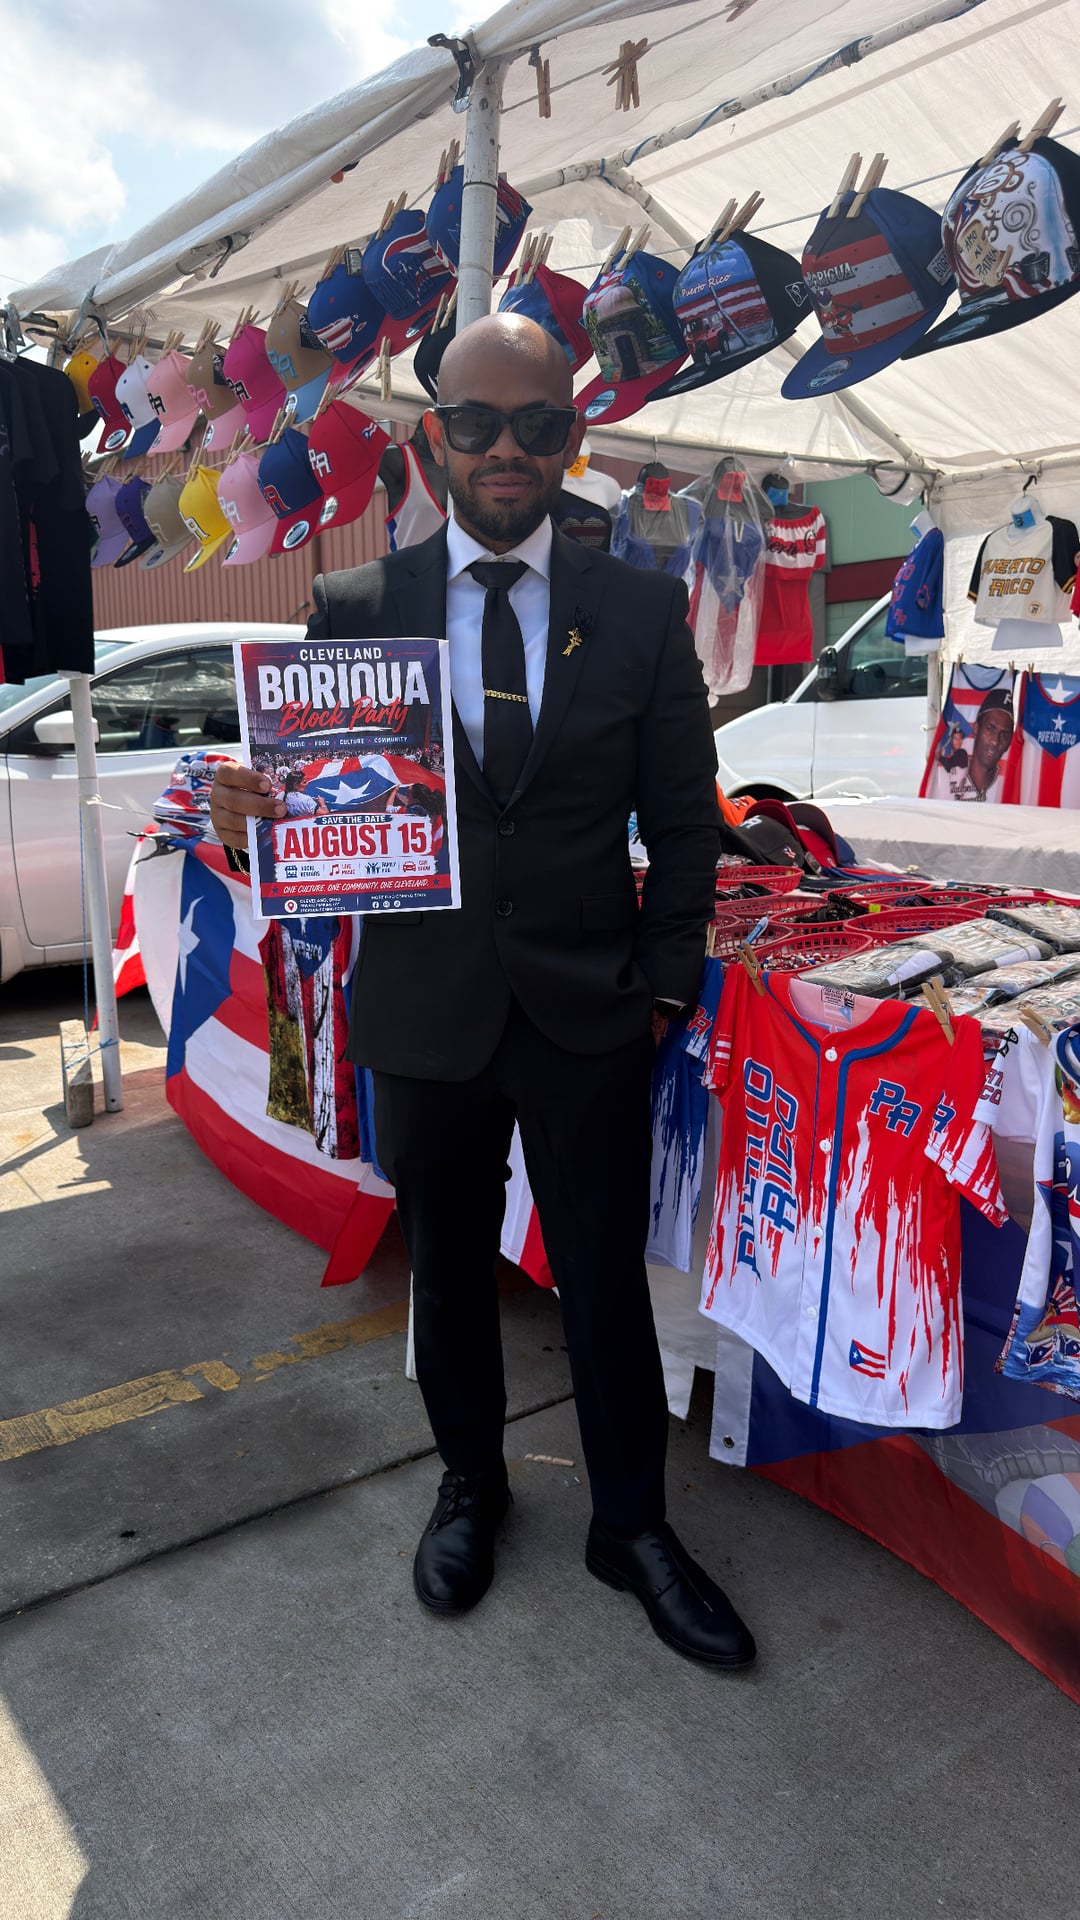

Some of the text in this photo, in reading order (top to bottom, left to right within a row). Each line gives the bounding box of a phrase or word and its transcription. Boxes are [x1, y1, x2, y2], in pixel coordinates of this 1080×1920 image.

[681, 273, 732, 297] Puerto Rico
[988, 578, 1035, 597] RICO
[300, 647, 383, 662] CLEVELAND
[257, 660, 430, 711] BORIQUA
[276, 695, 409, 737] Block Party
[339, 738, 365, 746] CULTURE
[374, 736, 408, 744] COMMUNITY
[321, 814, 386, 825] SAVE THE DATE
[283, 822, 428, 860] AUGUST 15
[283, 877, 429, 894] ONE CULTURE. ONE COMMUNITY. ONE CLEVELAND.
[868, 1078, 922, 1138] PR
[760, 1084, 799, 1234] RICO
